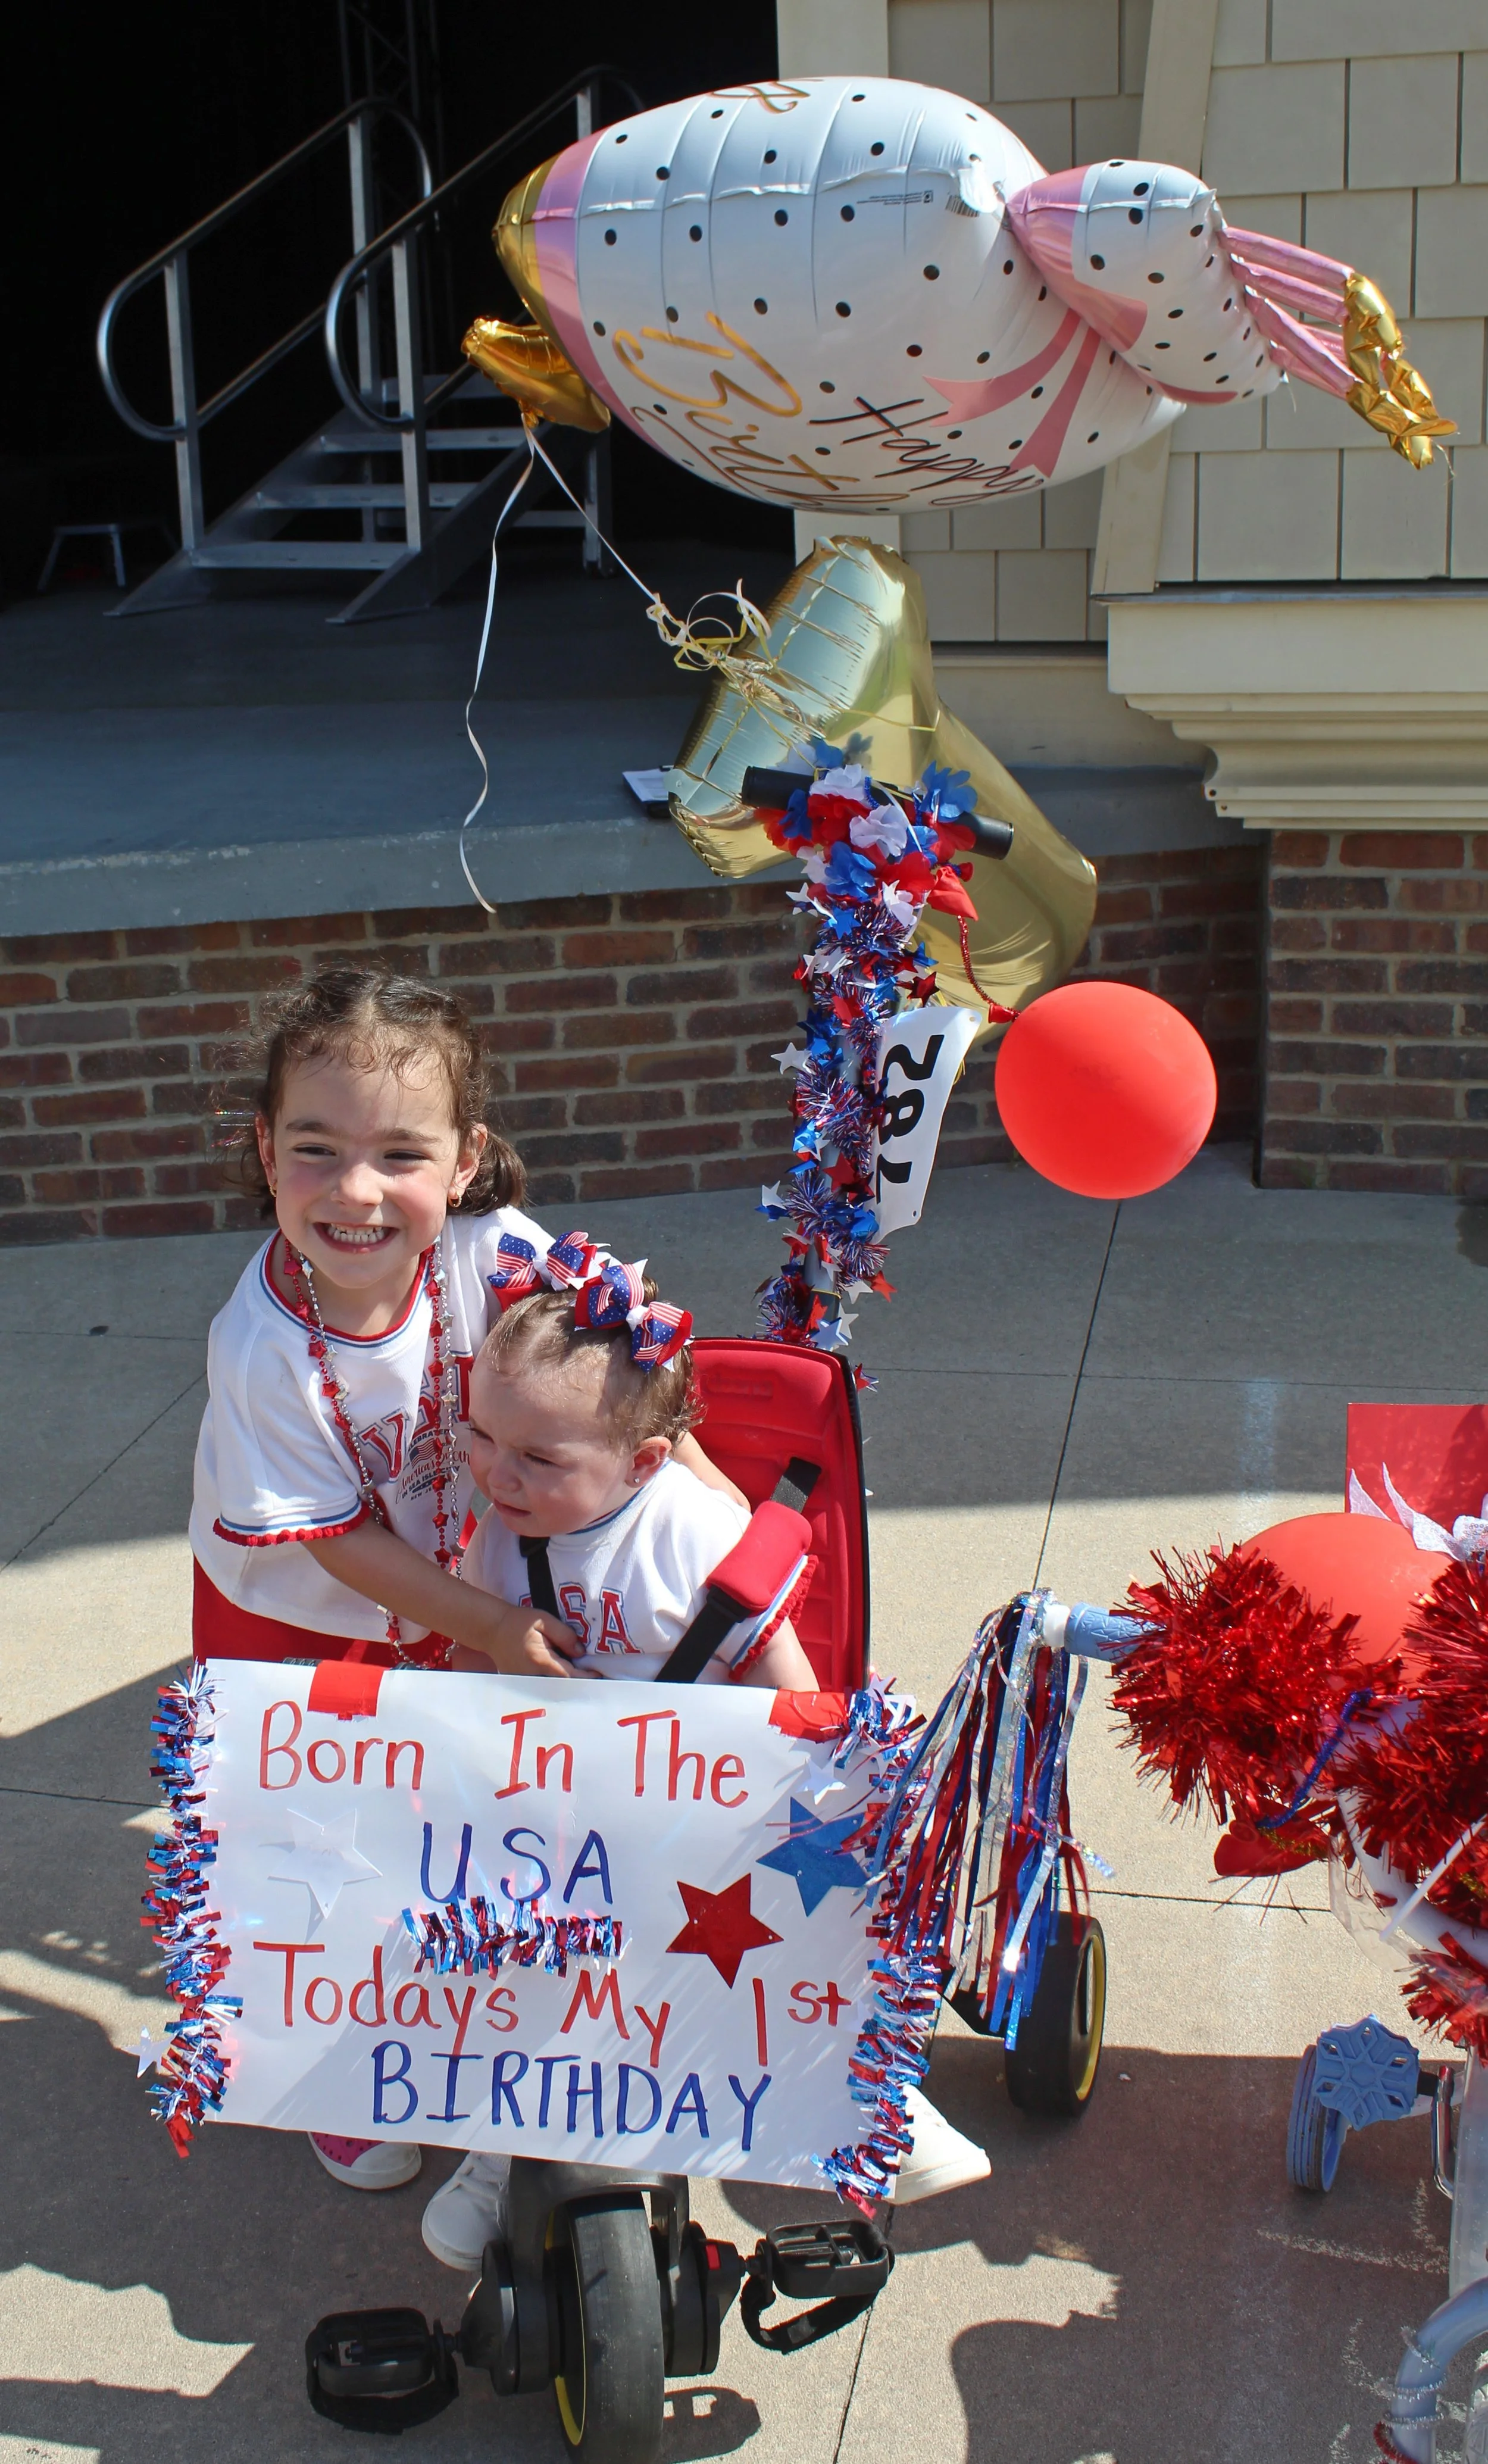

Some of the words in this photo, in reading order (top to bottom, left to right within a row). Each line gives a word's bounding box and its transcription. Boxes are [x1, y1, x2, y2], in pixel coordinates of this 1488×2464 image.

[806, 396, 1045, 507] Happy
[260, 1700, 424, 1790] Born
[495, 1709, 573, 1799] In
[617, 1709, 749, 1808] The
[420, 1822, 613, 1904] USA
[252, 1941, 518, 2056] Todays
[561, 1968, 671, 2068] My
[371, 2040, 772, 2151] BIRTHDAY
